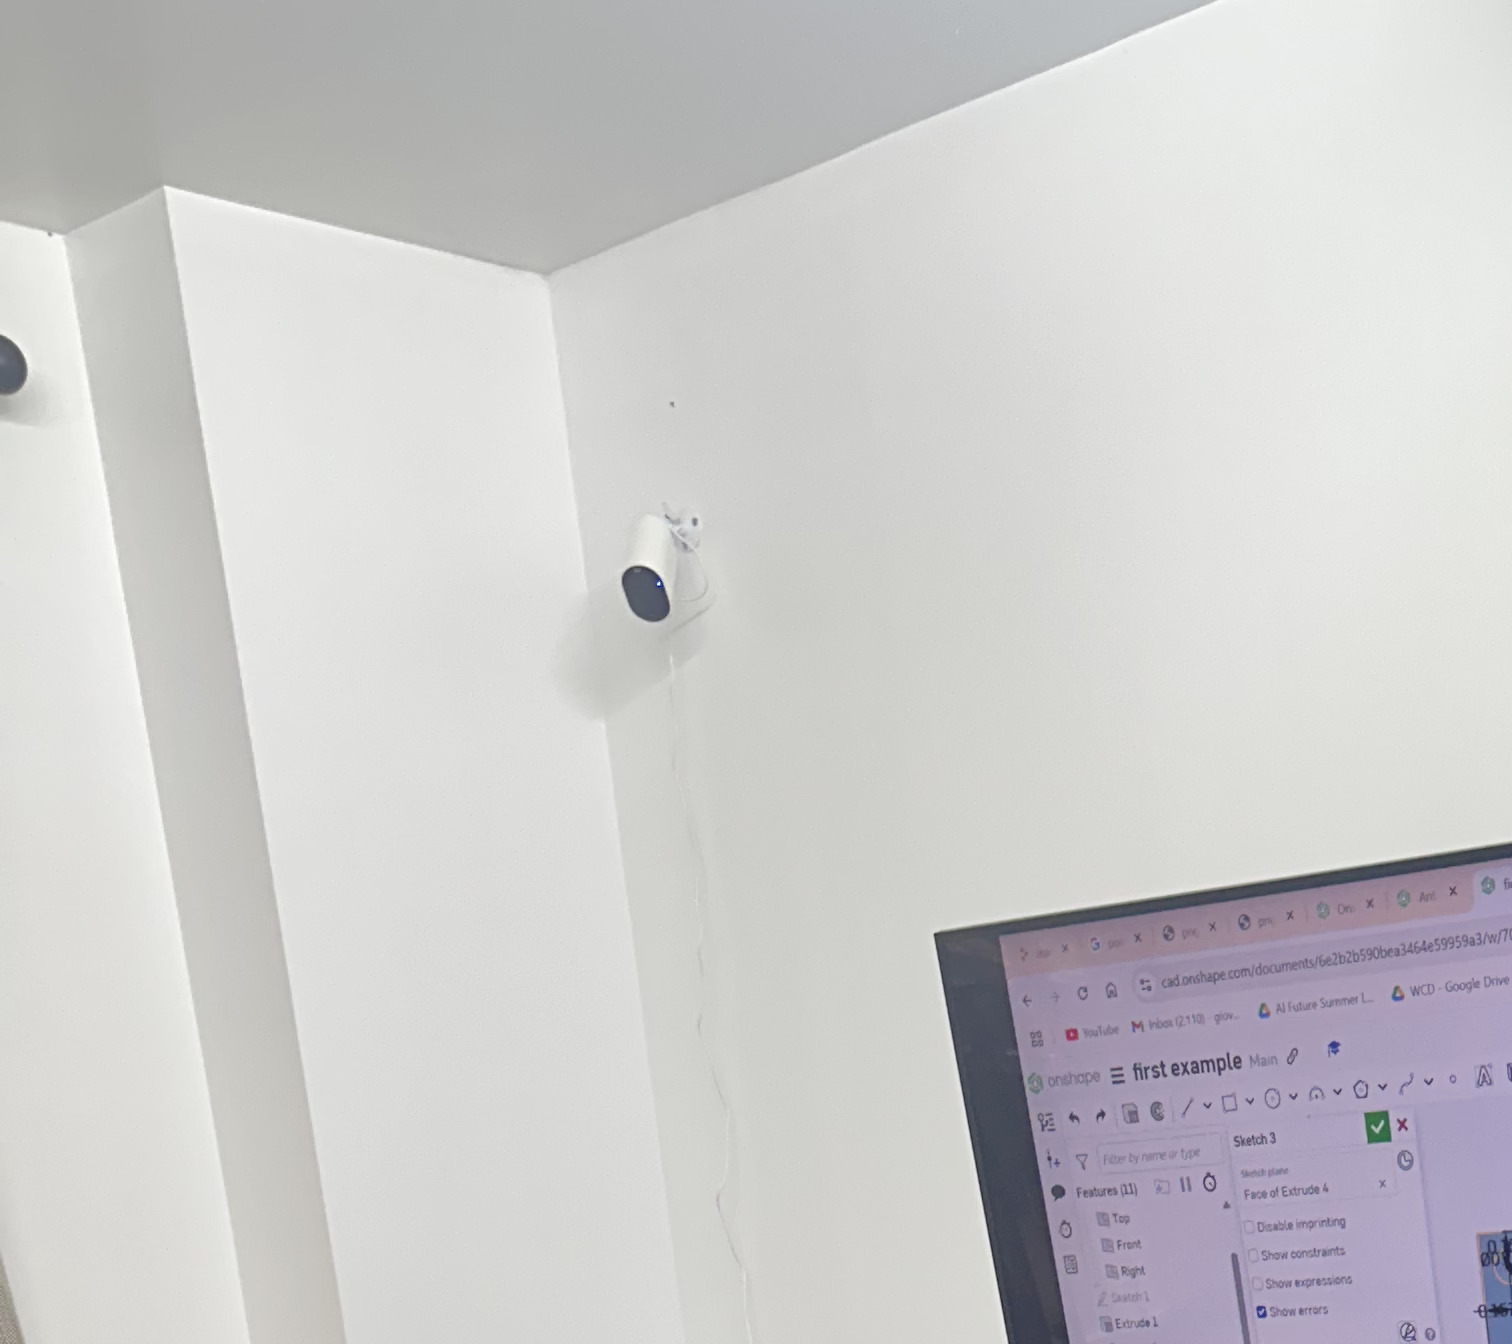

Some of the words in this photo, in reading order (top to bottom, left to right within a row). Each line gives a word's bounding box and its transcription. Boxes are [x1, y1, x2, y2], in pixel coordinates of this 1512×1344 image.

[1410, 984, 1435, 997] WCD
[1445, 978, 1480, 994] Google
[1484, 975, 1510, 989] Drive
[1288, 999, 1318, 1013] Future
[1319, 995, 1359, 1010] Summer
[1132, 1061, 1168, 1082] first
[1171, 1052, 1243, 1077] example
[1250, 1053, 1278, 1068] Main
[1048, 1070, 1101, 1088] onshape
[1233, 1133, 1268, 1148] Sketch
[1269, 1132, 1277, 1145] 3
[1076, 1185, 1118, 1199] Features
[1244, 1187, 1268, 1200] Face
[1269, 1186, 1280, 1197] of
[1281, 1184, 1320, 1197] Extrude
[1112, 1213, 1131, 1225] Top
[1256, 1220, 1294, 1233] Disable
[1296, 1217, 1346, 1231] imprinting
[1116, 1239, 1142, 1250] Front
[1261, 1249, 1289, 1261] Show
[1290, 1246, 1346, 1260] constraints
[1121, 1266, 1146, 1279] Right
[1265, 1277, 1292, 1289] Show
[1294, 1275, 1353, 1289] expressions
[1269, 1305, 1297, 1317] Show
[1298, 1305, 1329, 1316] errors
[1115, 1318, 1151, 1330] Extrude
